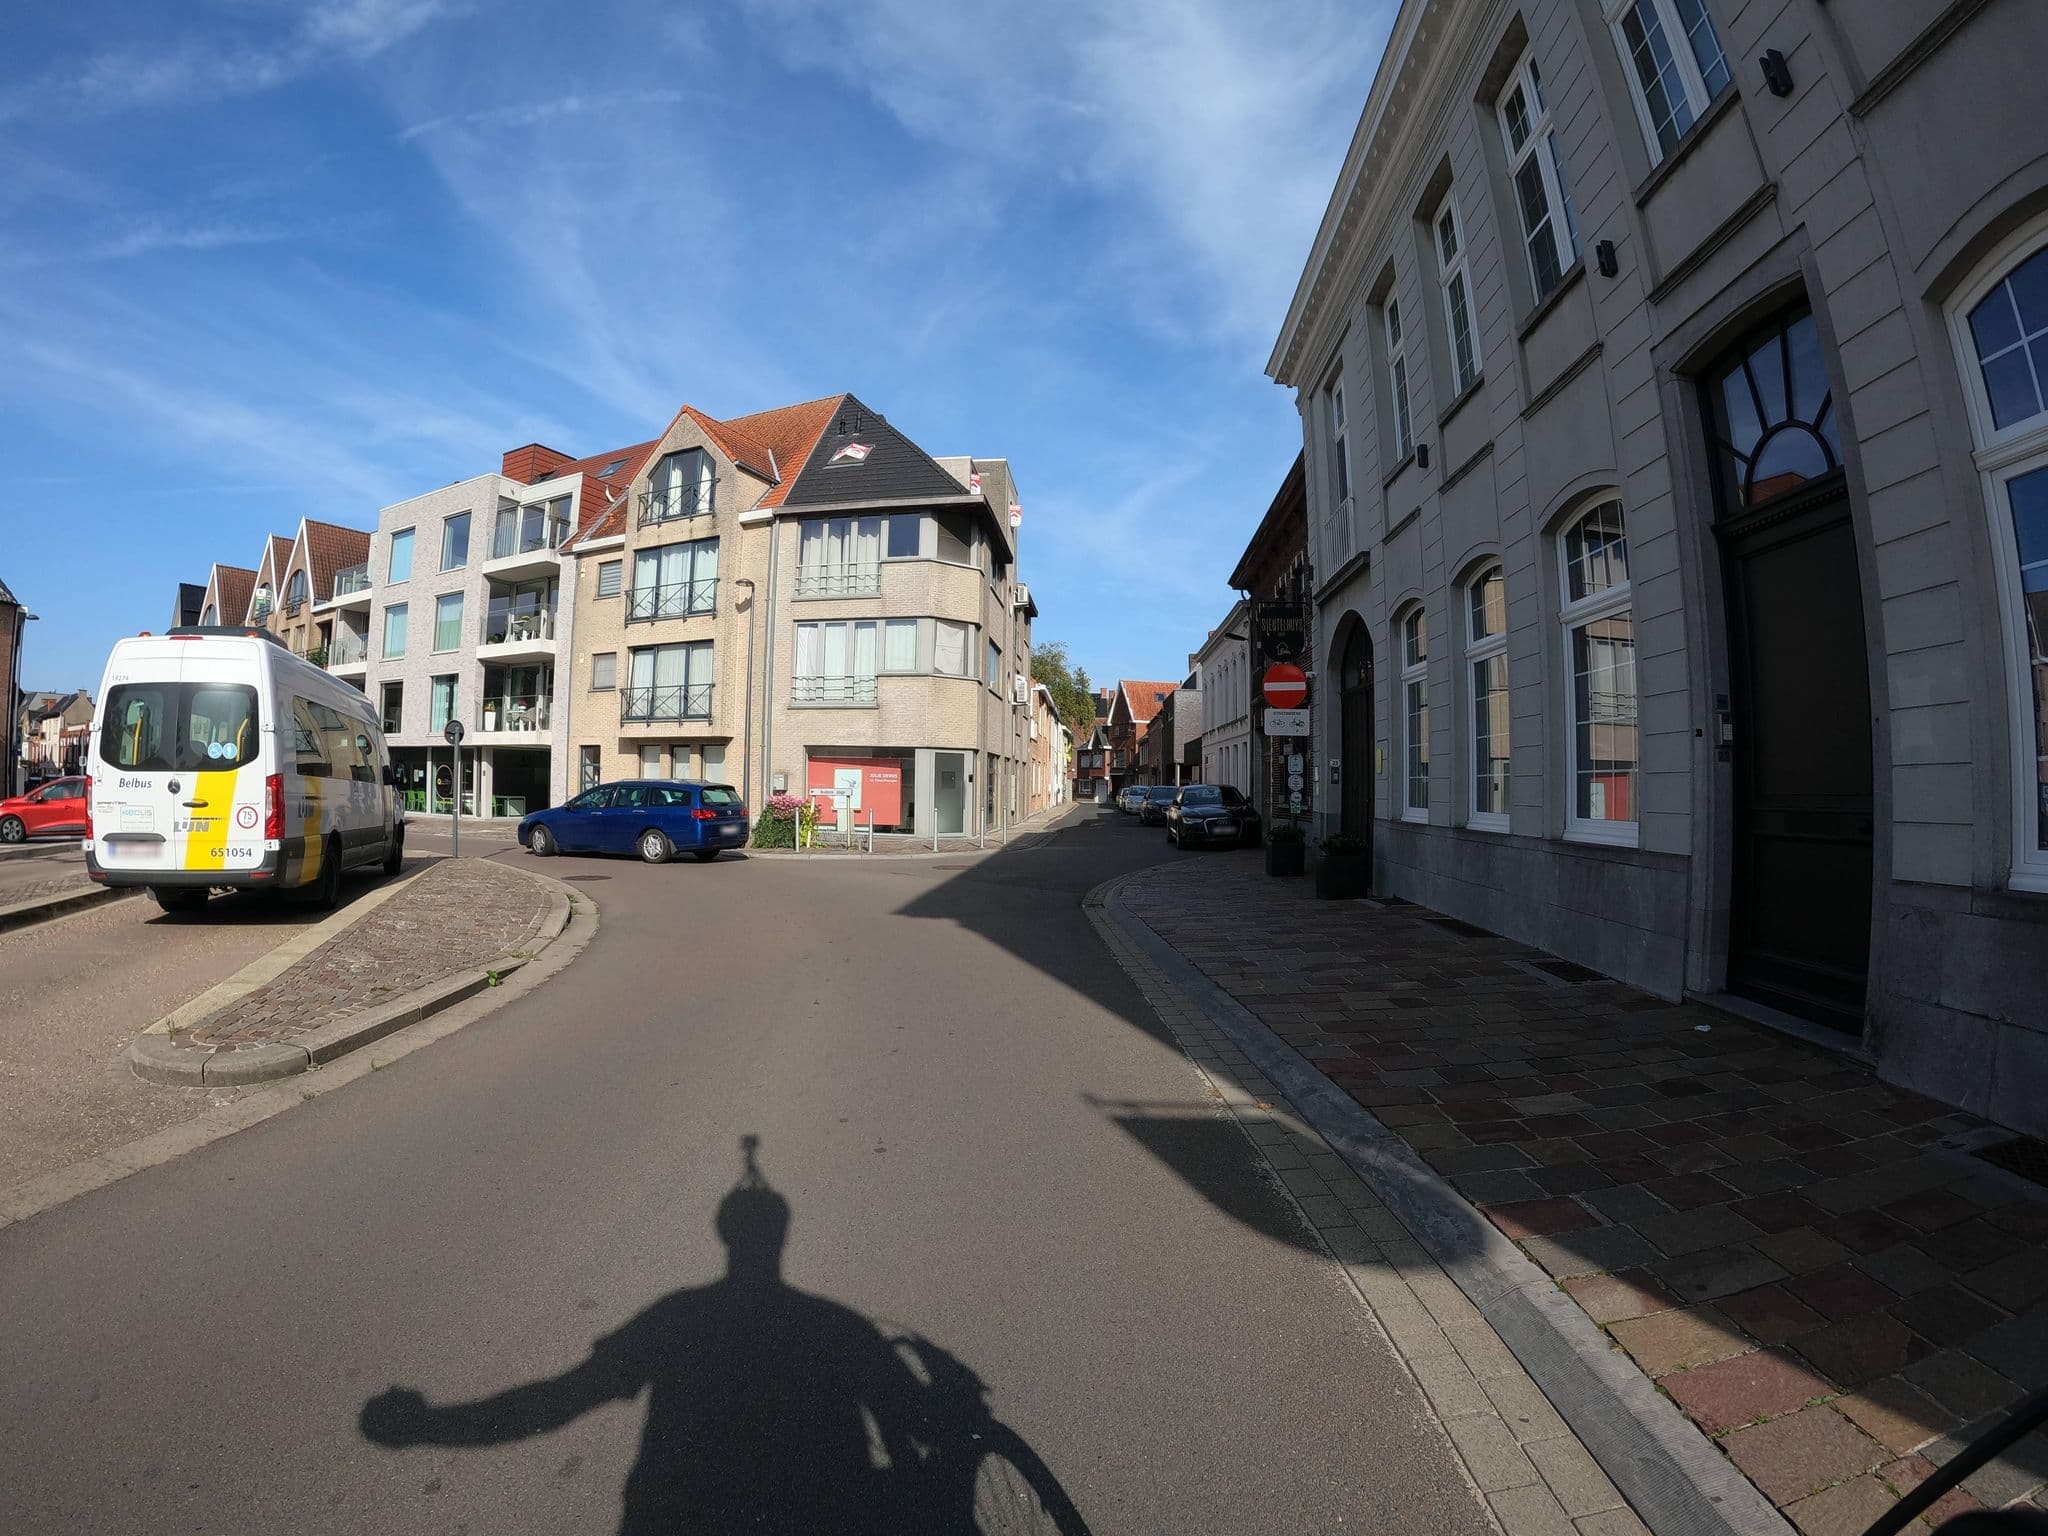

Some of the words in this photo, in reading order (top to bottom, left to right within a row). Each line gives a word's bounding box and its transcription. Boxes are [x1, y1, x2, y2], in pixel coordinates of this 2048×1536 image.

[118, 777, 153, 788] Belbus
[242, 811, 253, 820] 75
[210, 847, 253, 858] 651054
